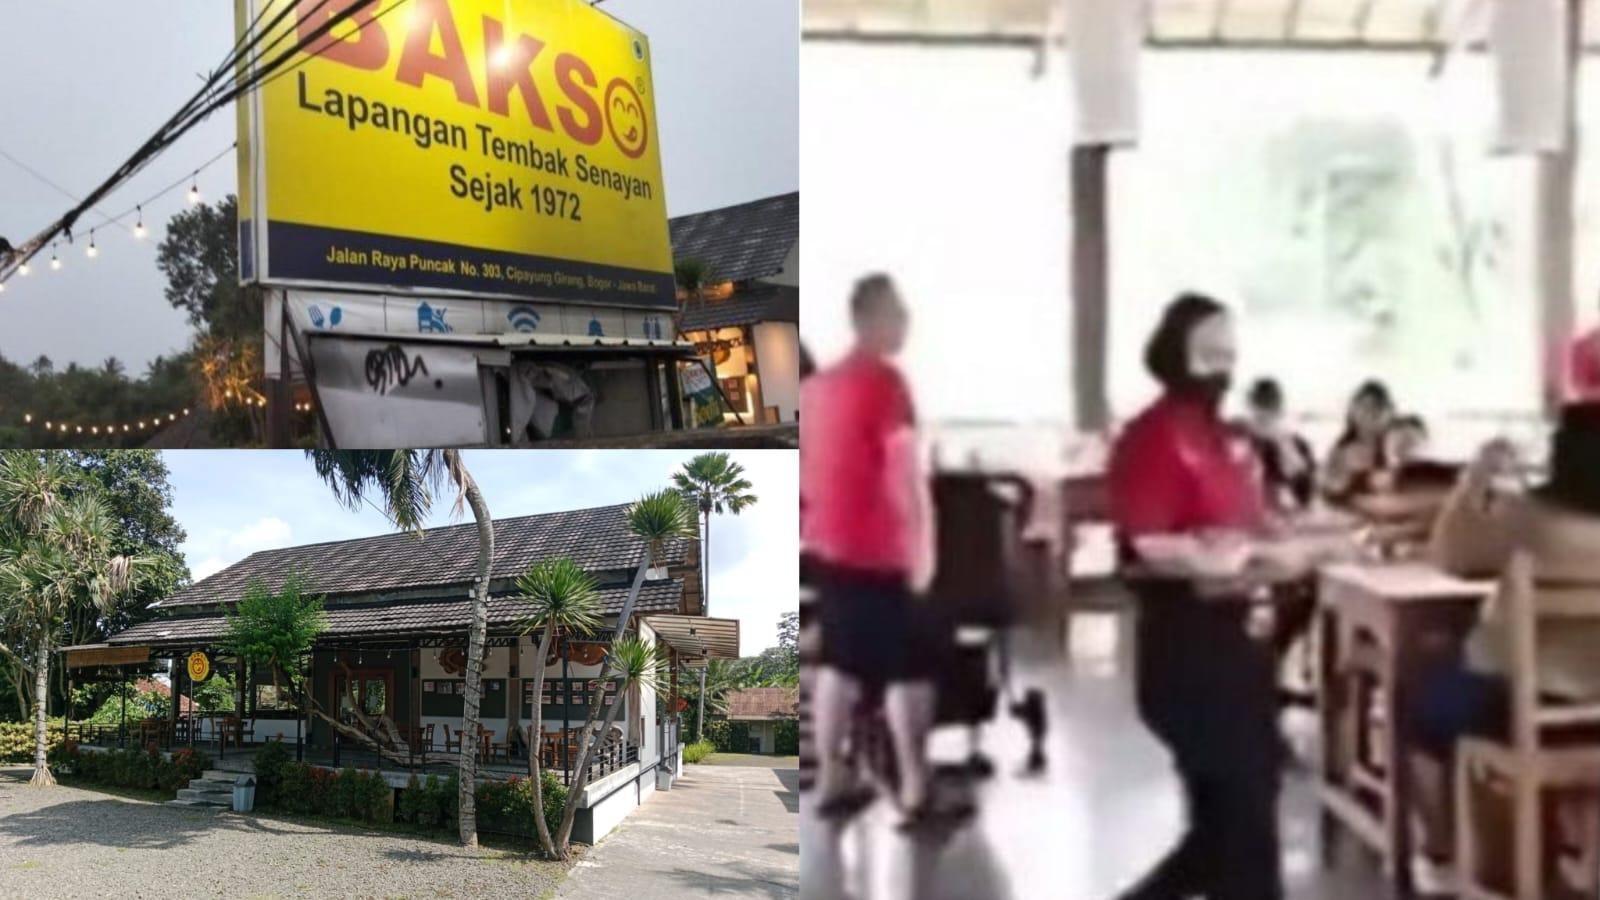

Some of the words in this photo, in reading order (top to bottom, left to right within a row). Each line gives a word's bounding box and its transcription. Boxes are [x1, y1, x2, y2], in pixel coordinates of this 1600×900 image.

[297, 70, 467, 150] Lapangan
[475, 123, 569, 177] Tembak
[575, 154, 652, 200] Senayan
[450, 164, 523, 212] Sejak
[530, 184, 582, 222] 1972
[326, 245, 368, 265] Jalan
[371, 250, 407, 272] Raya
[409, 254, 456, 274] Puncak
[460, 261, 480, 277] No.
[482, 263, 504, 280] 303,
[506, 265, 552, 287] Cipayung
